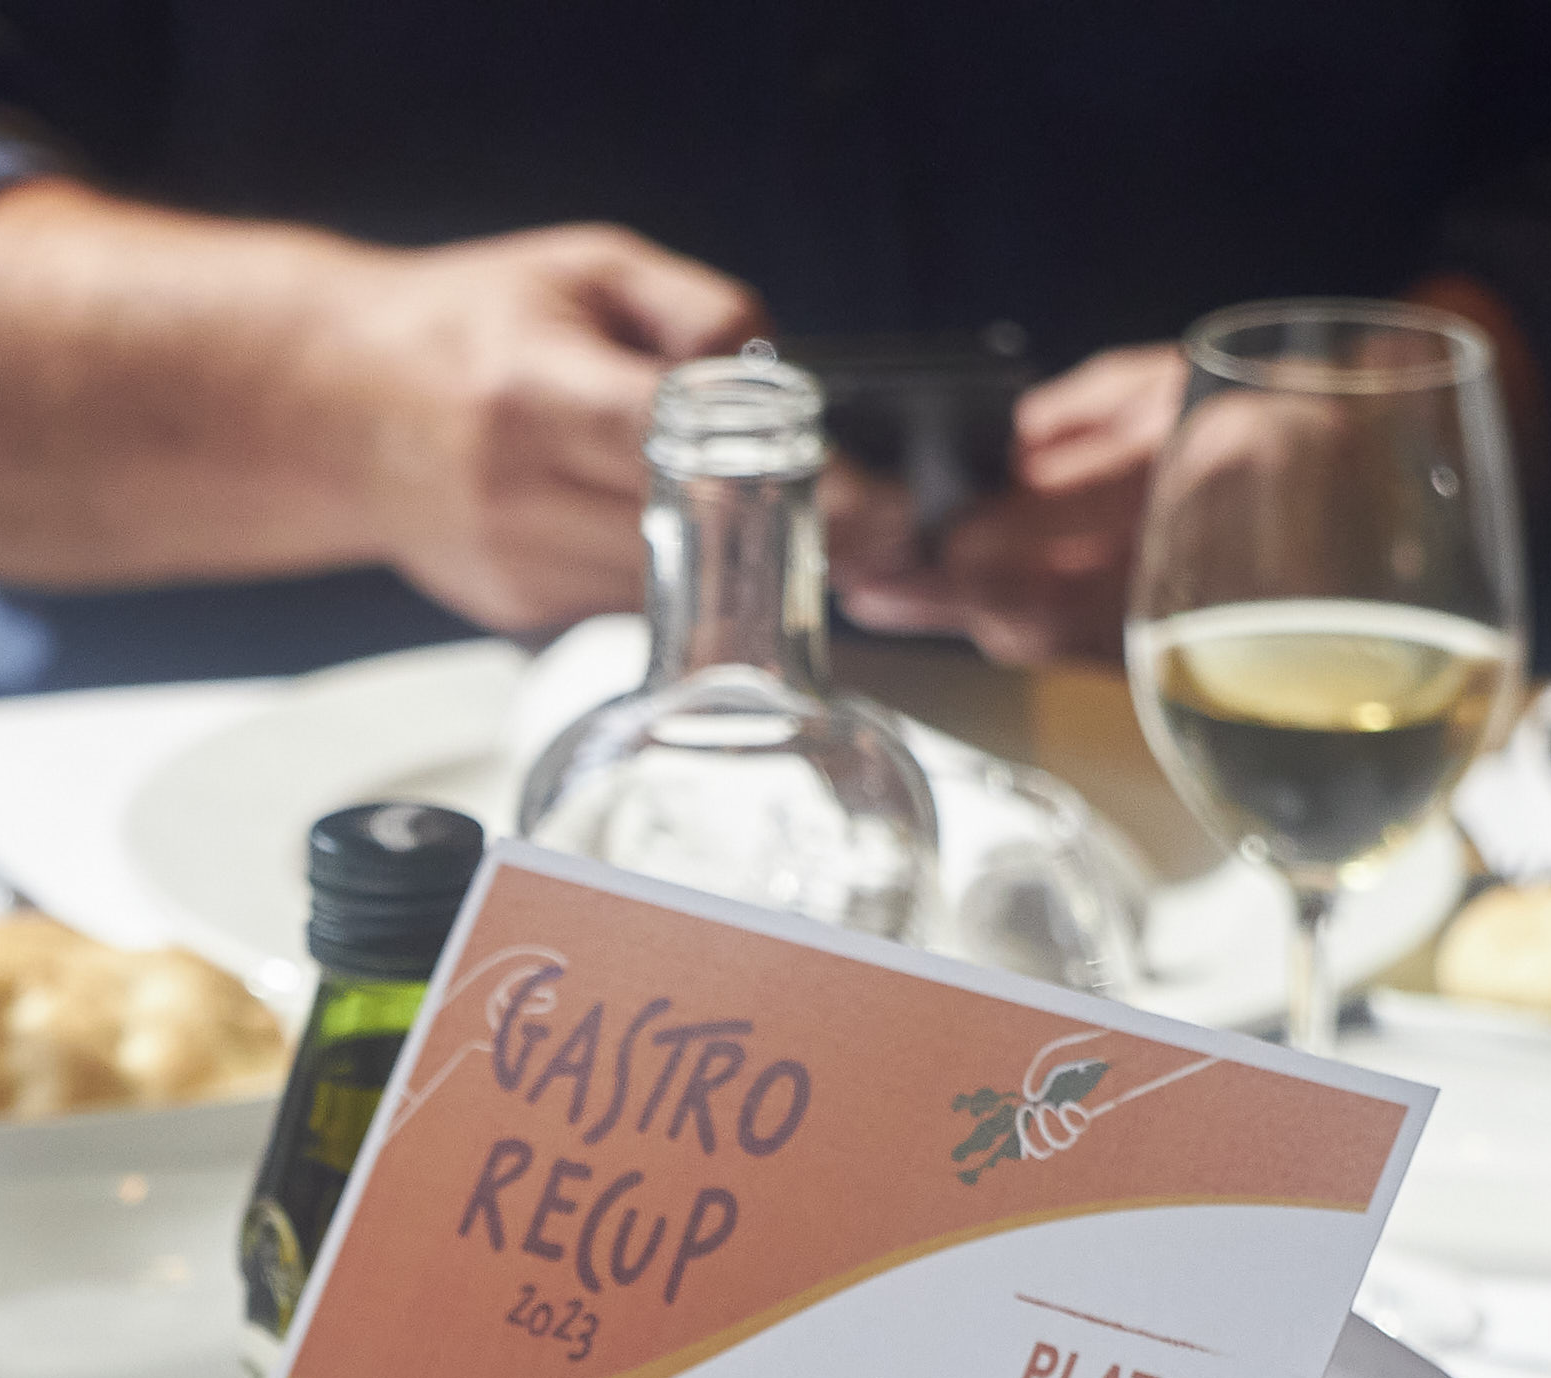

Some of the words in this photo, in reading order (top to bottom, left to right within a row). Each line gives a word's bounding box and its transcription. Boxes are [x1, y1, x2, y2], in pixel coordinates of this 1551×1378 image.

[494, 964, 812, 1157] GASTRO
[458, 1137, 738, 1306] RECUP
[506, 1284, 599, 1361] 2023
